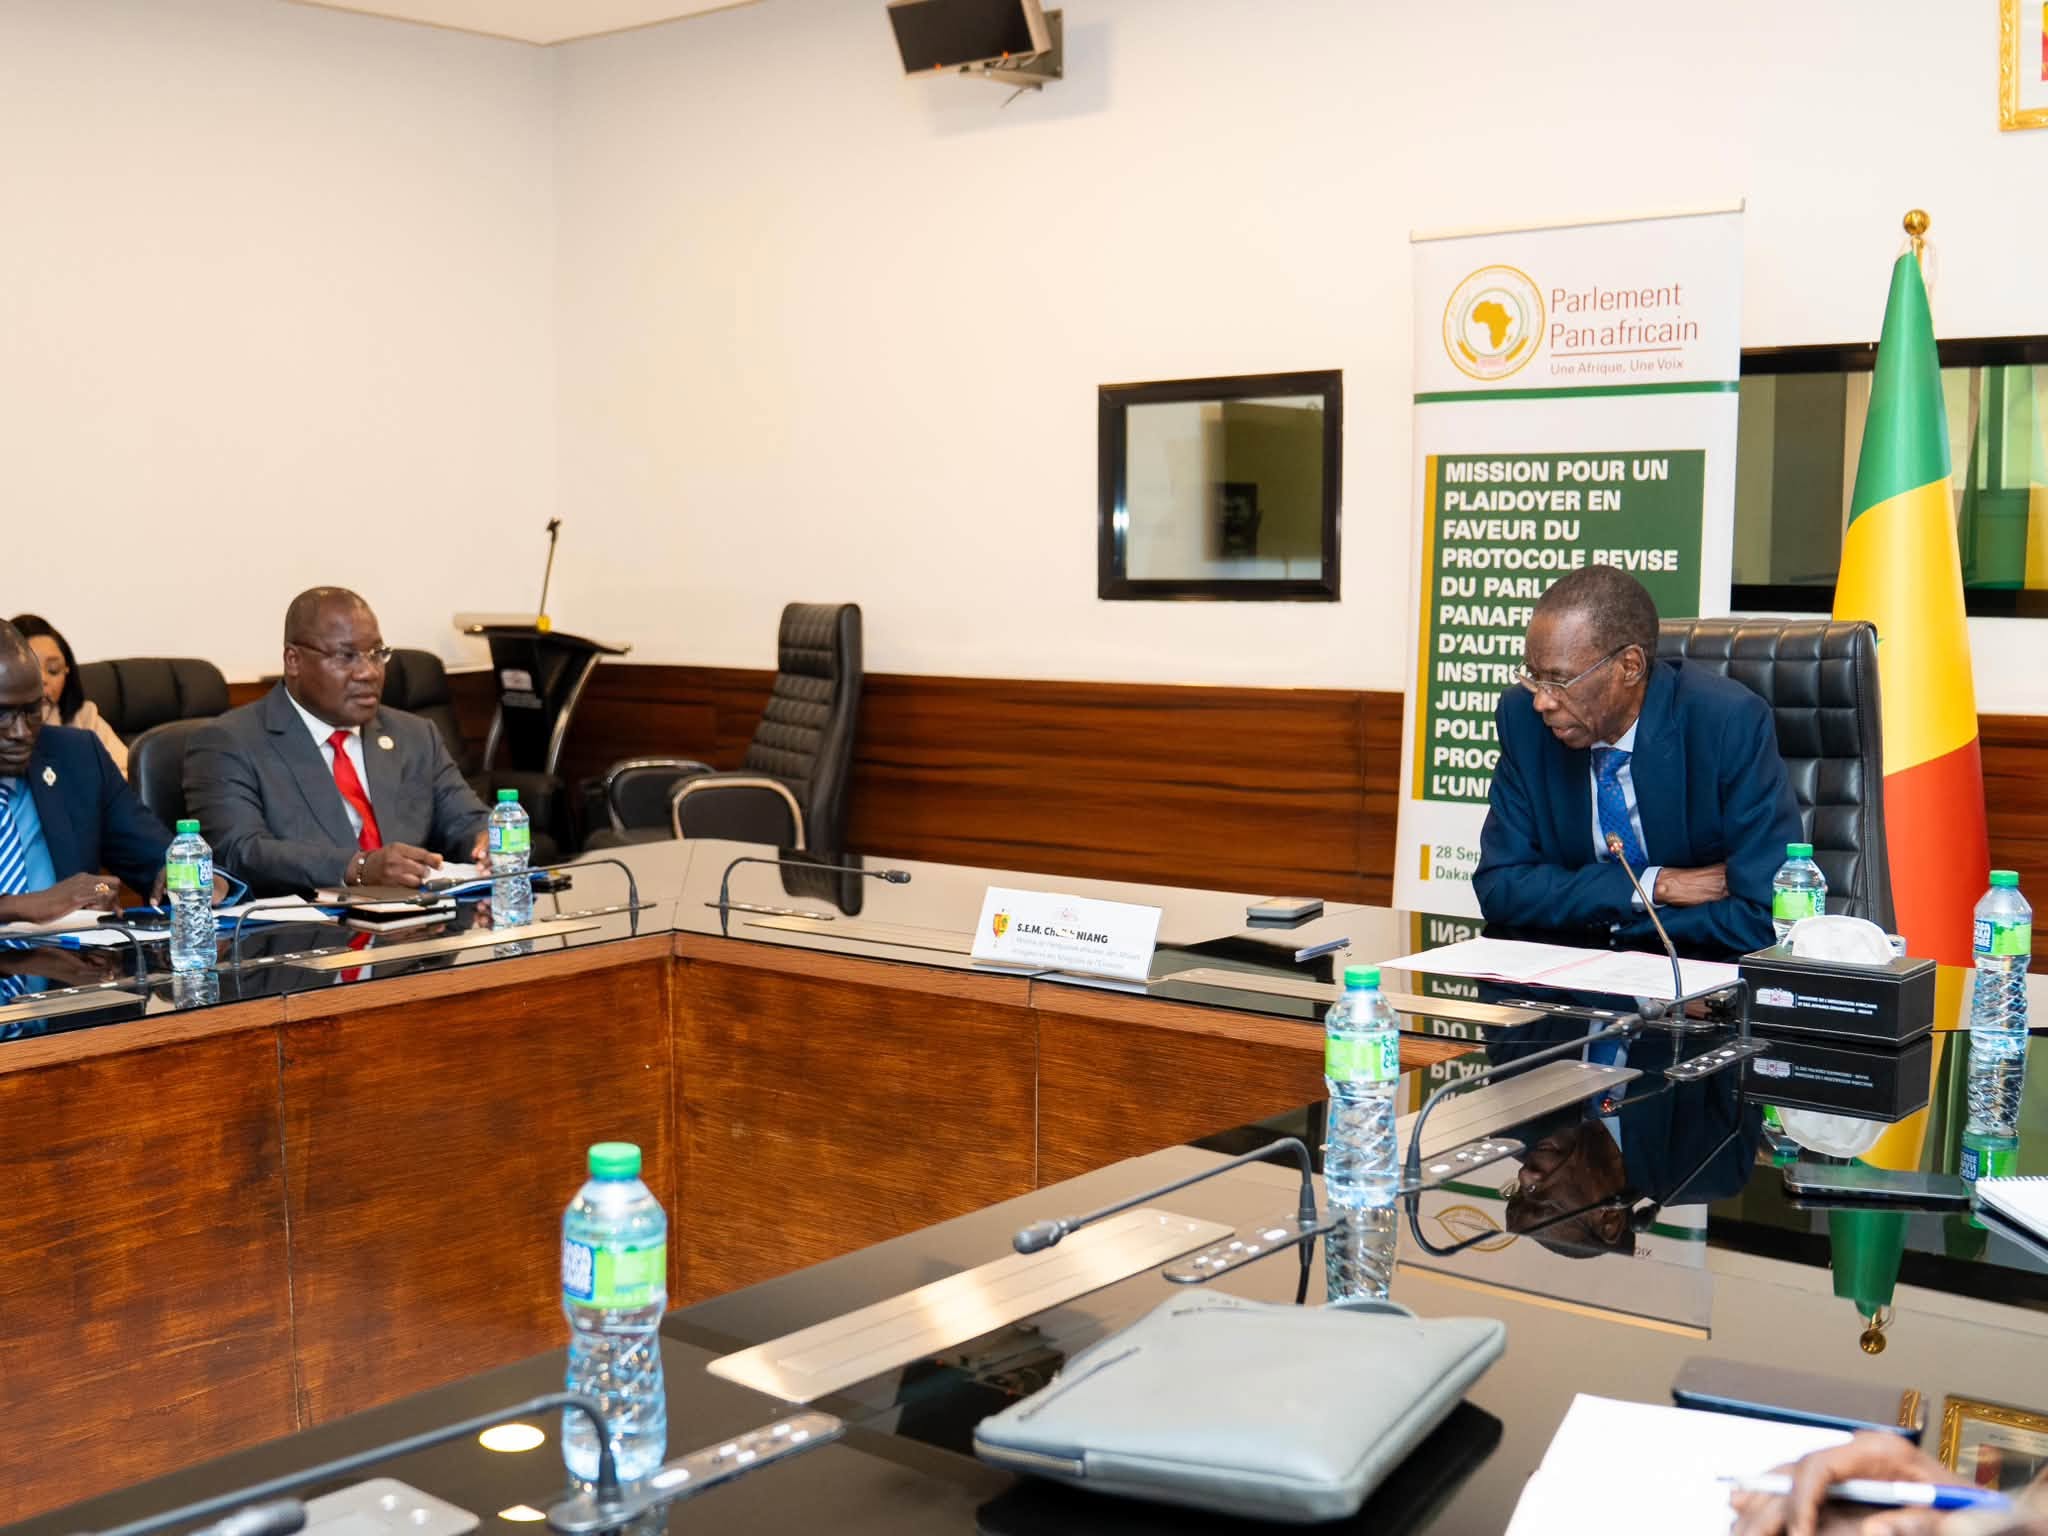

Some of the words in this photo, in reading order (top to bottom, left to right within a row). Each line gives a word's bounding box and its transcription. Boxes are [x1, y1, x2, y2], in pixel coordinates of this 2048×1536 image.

[1551, 283, 1682, 313] Parlement
[1550, 363, 1575, 375] Une
[1578, 361, 1626, 376] Afrique,
[1630, 360, 1655, 372] Une
[1657, 357, 1684, 370] Voix
[1445, 461, 1550, 483] MISSION
[1556, 460, 1626, 482] POUR
[1632, 459, 1669, 481] UN
[1444, 490, 1581, 511] PLAIDOYER
[1588, 490, 1621, 511] EN
[1443, 519, 1537, 541] FAVEUR
[1543, 519, 1581, 541] DU
[1442, 547, 1586, 570] PROTOCOLE
[1592, 549, 1679, 571] REVISE
[1440, 576, 1477, 598] DU
[1435, 846, 1452, 859] 28
[1017, 923, 1042, 935] S.E.M.
[1076, 931, 1109, 944] NIANG
